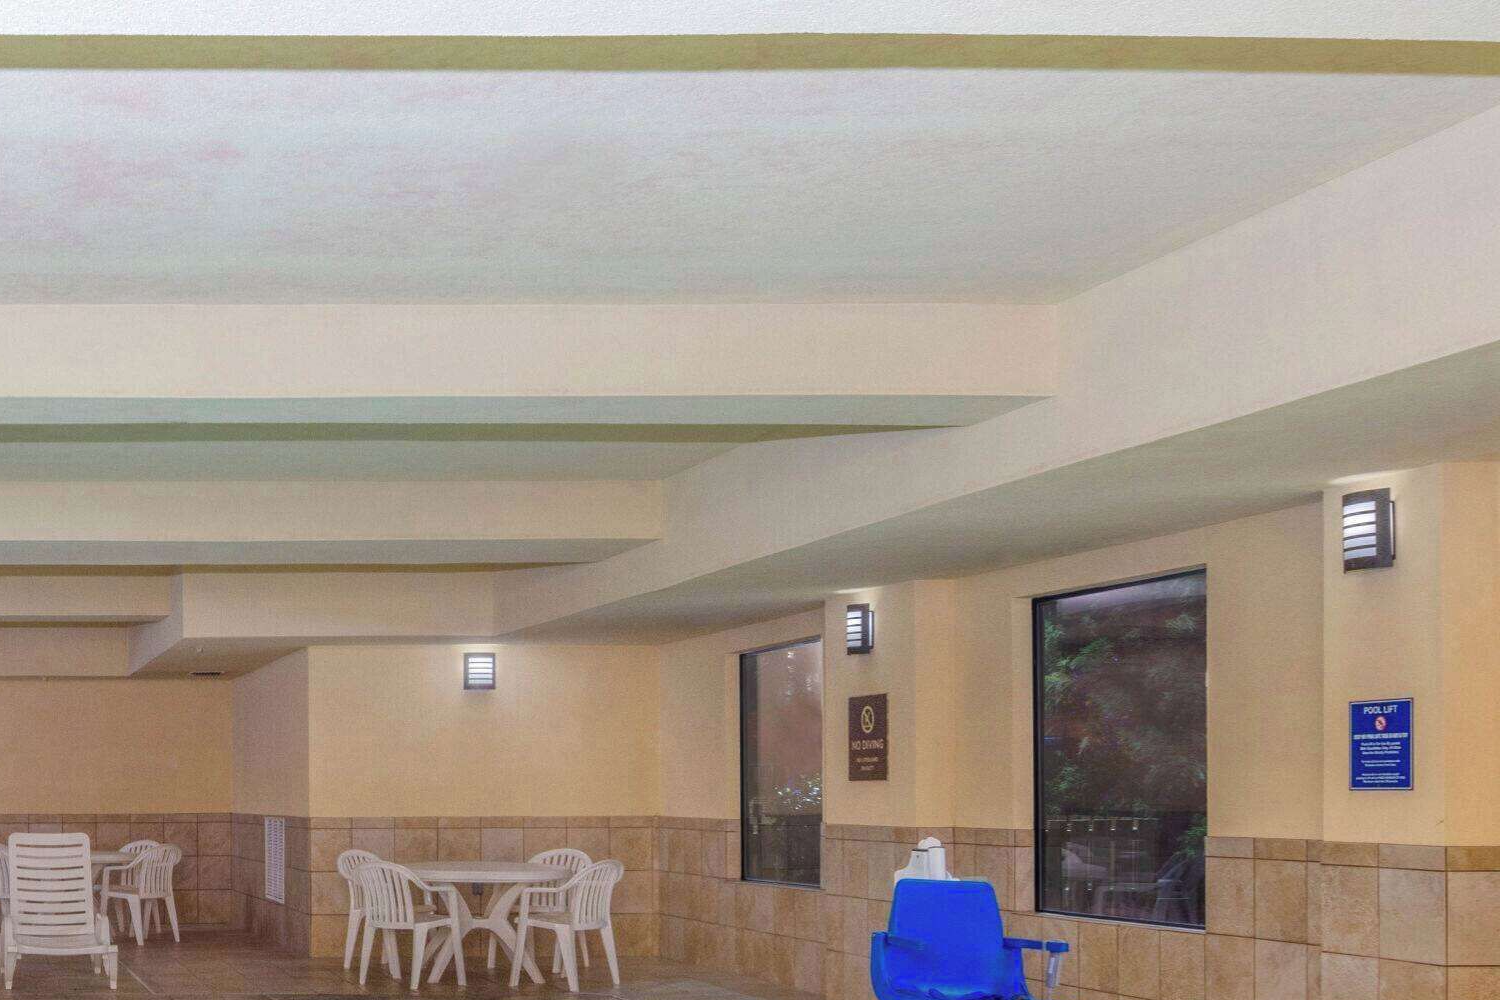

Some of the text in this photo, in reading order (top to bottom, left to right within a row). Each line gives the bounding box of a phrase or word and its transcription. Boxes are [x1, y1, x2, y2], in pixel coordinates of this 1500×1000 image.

[1363, 704, 1398, 714] POOL LIFT
[852, 740, 861, 750] NO
